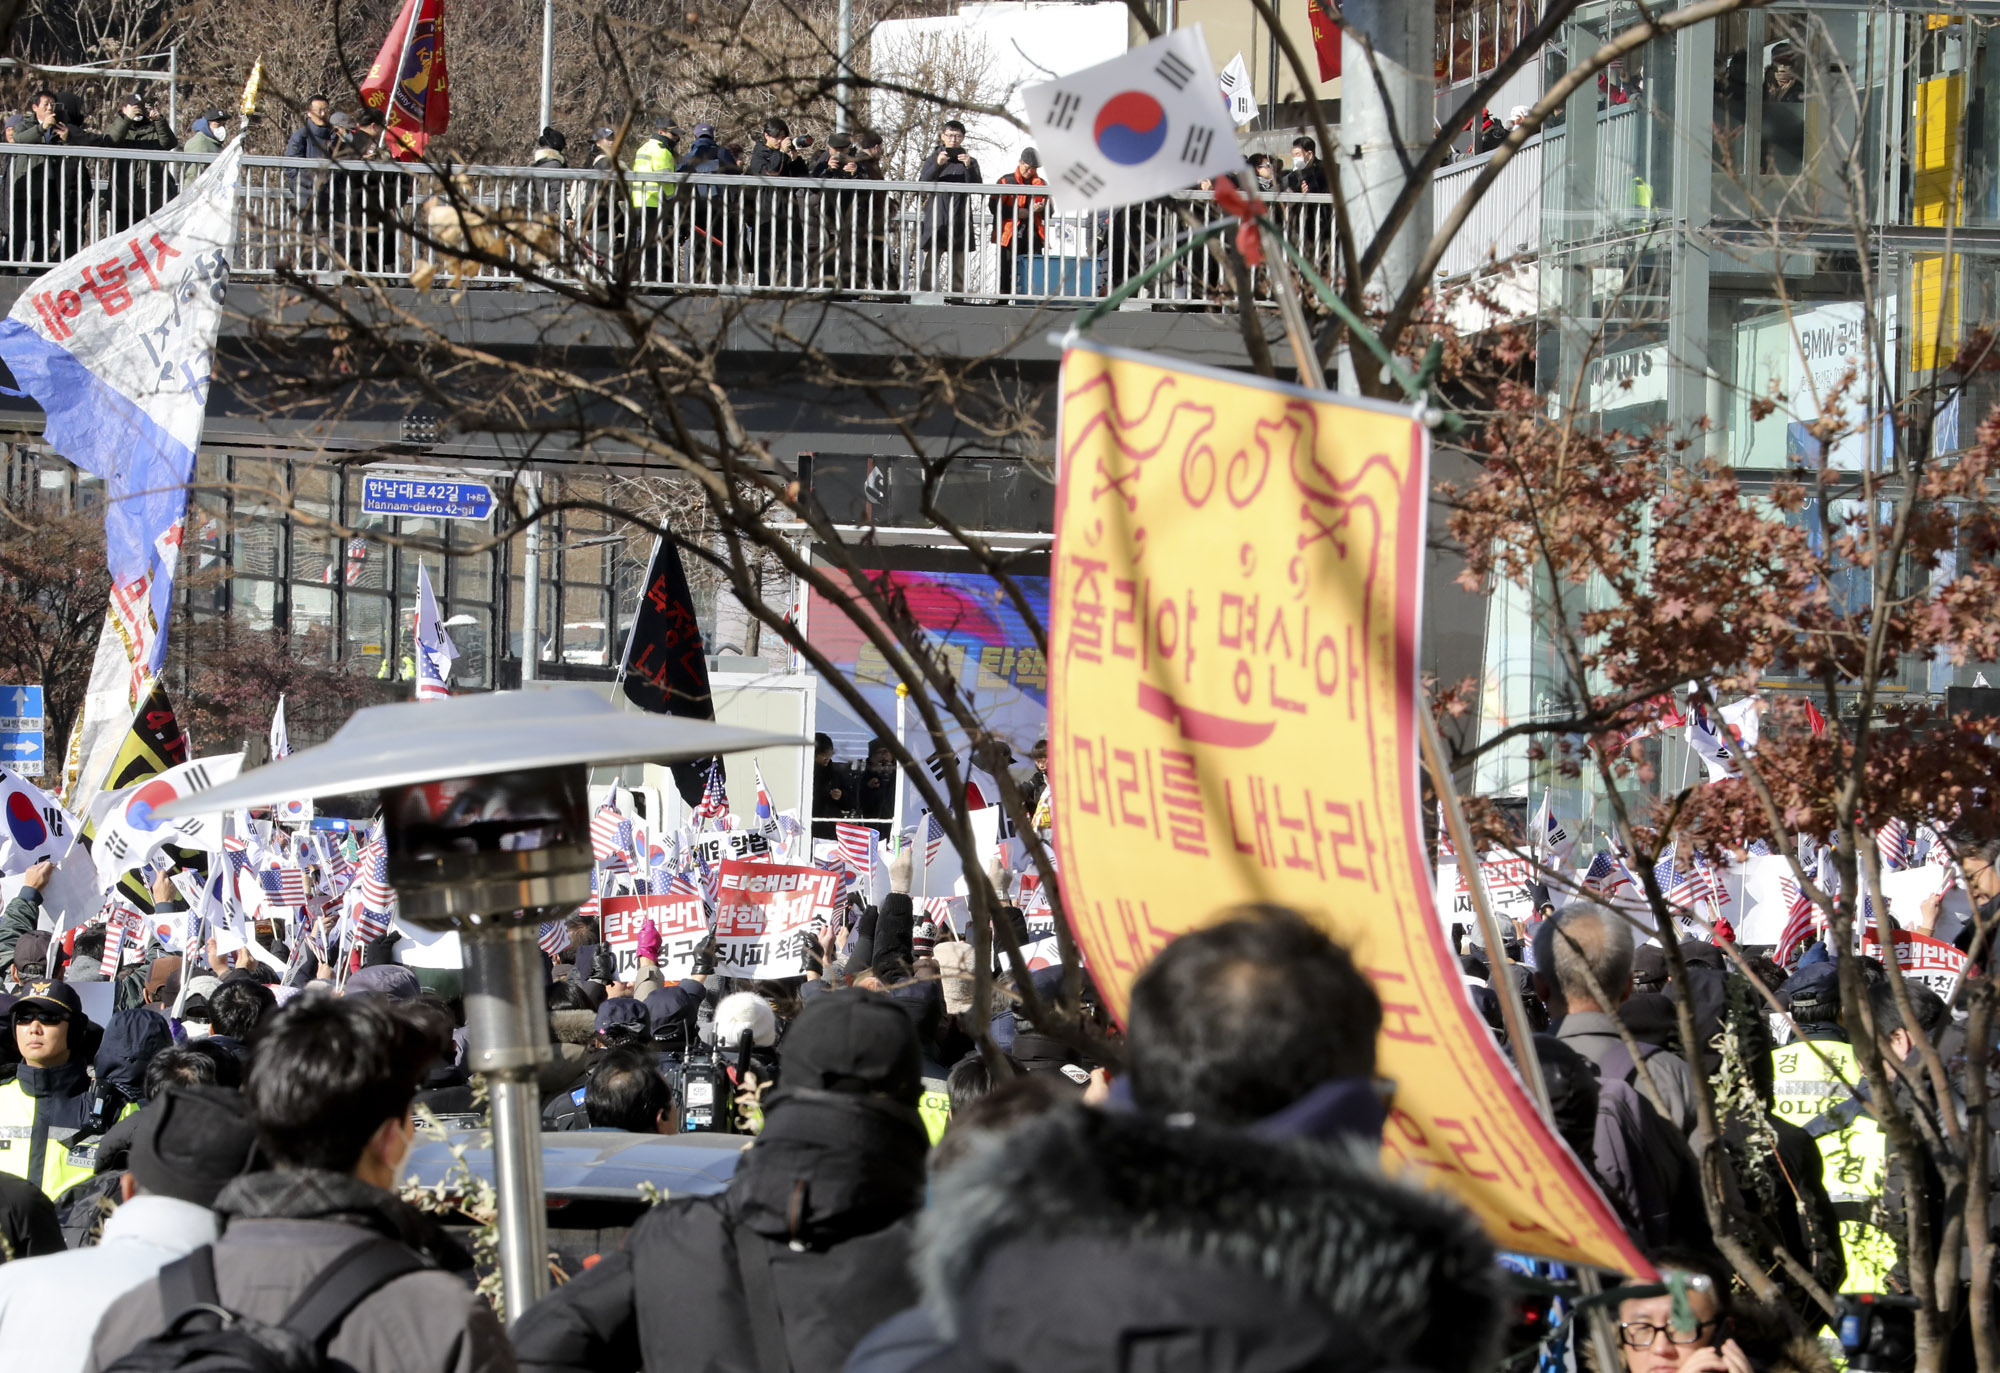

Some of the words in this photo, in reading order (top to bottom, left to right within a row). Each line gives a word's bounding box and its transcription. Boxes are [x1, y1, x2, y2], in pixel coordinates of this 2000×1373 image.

[1802, 326, 1835, 360] BMW
[367, 499, 443, 512] Hannam-daero
[445, 504, 475, 516] 42-gil
[368, 481, 459, 502] 한남대로42길
[1218, 592, 1360, 722] 명신아
[1073, 735, 1211, 858] 머리를
[1224, 774, 1380, 893] 내놔라
[604, 899, 707, 943] 탄핵반대
[717, 893, 815, 934] 탄핵반대
[68, 1157, 95, 1167] POLICE
